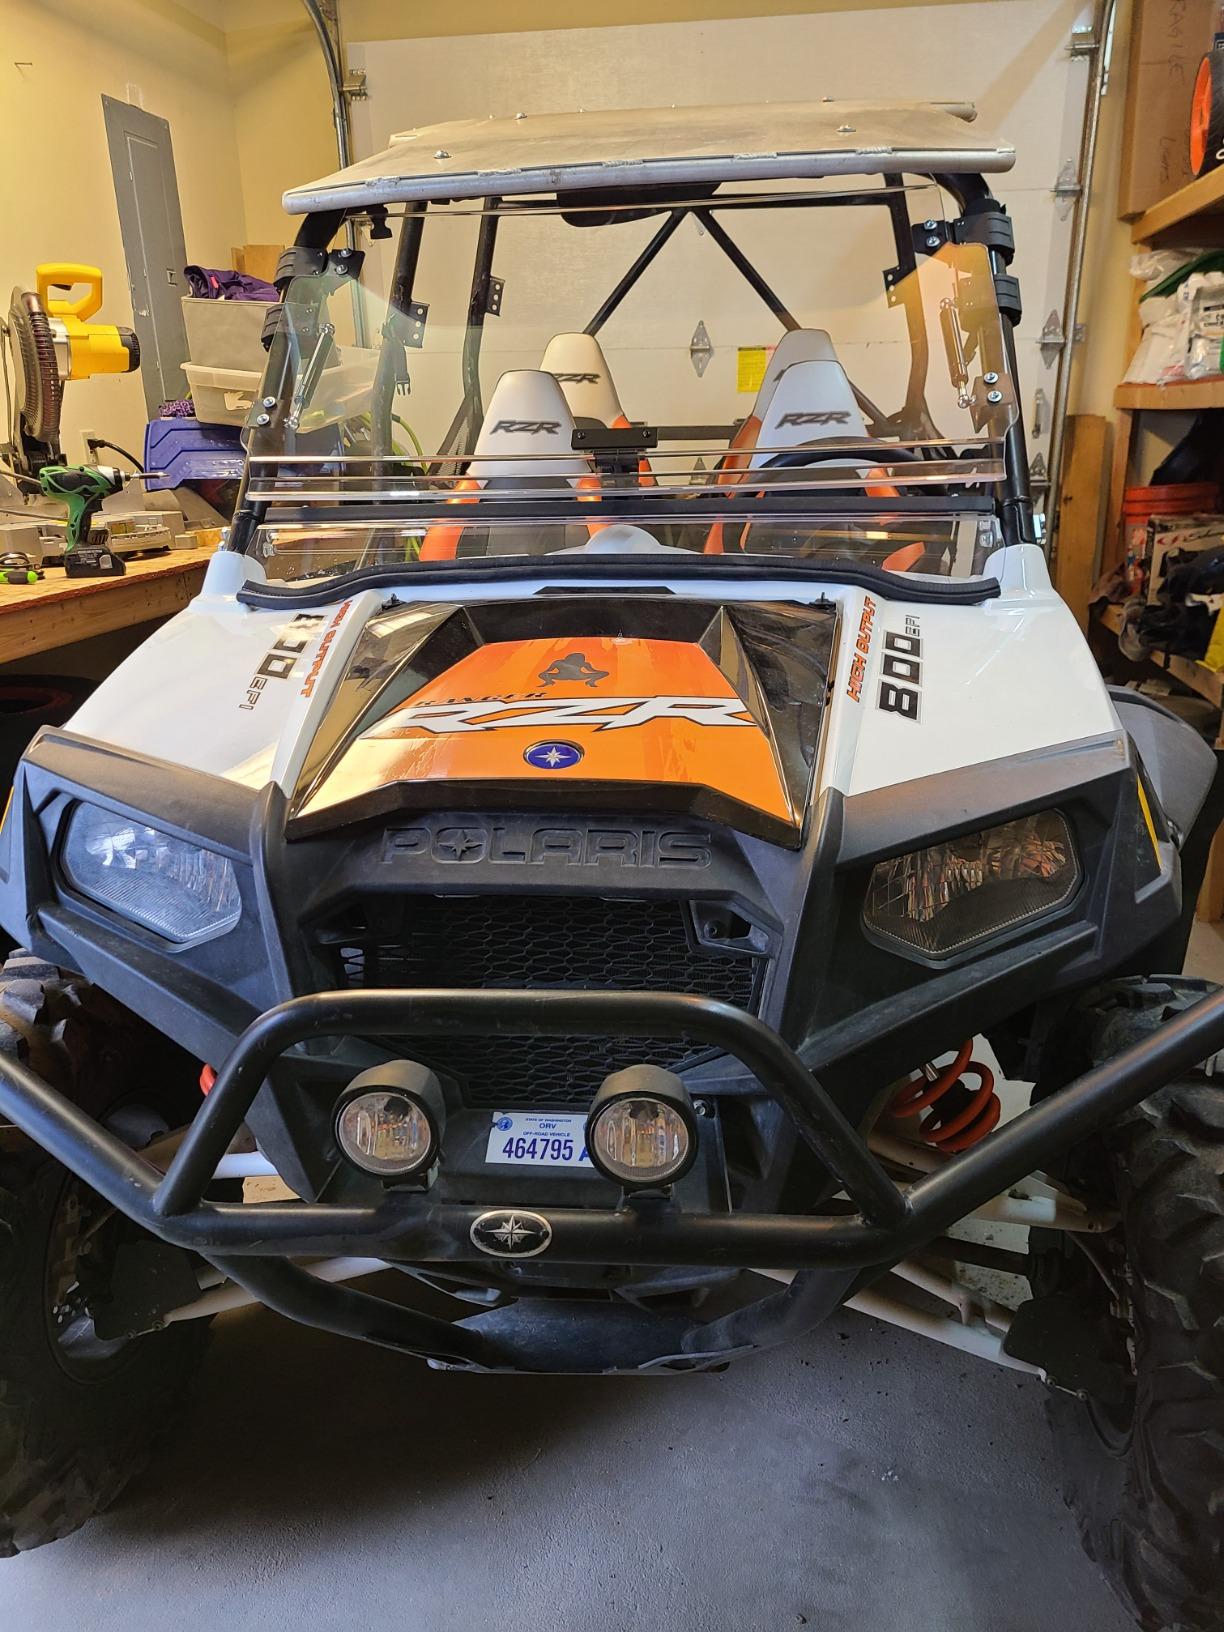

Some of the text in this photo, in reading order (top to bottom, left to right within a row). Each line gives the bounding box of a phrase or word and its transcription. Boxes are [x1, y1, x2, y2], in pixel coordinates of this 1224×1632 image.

[552, 373, 600, 384] ZR
[489, 420, 561, 435] RZR
[774, 410, 851, 430] RZR
[300, 629, 337, 698] OUTPUT
[847, 595, 877, 703] HIGH OUTPUT
[879, 614, 921, 721] 800 EFI
[238, 676, 268, 710] EFI
[359, 695, 759, 738] RZR
[380, 827, 713, 869] POLARIS
[502, 1137, 574, 1161] 464795
